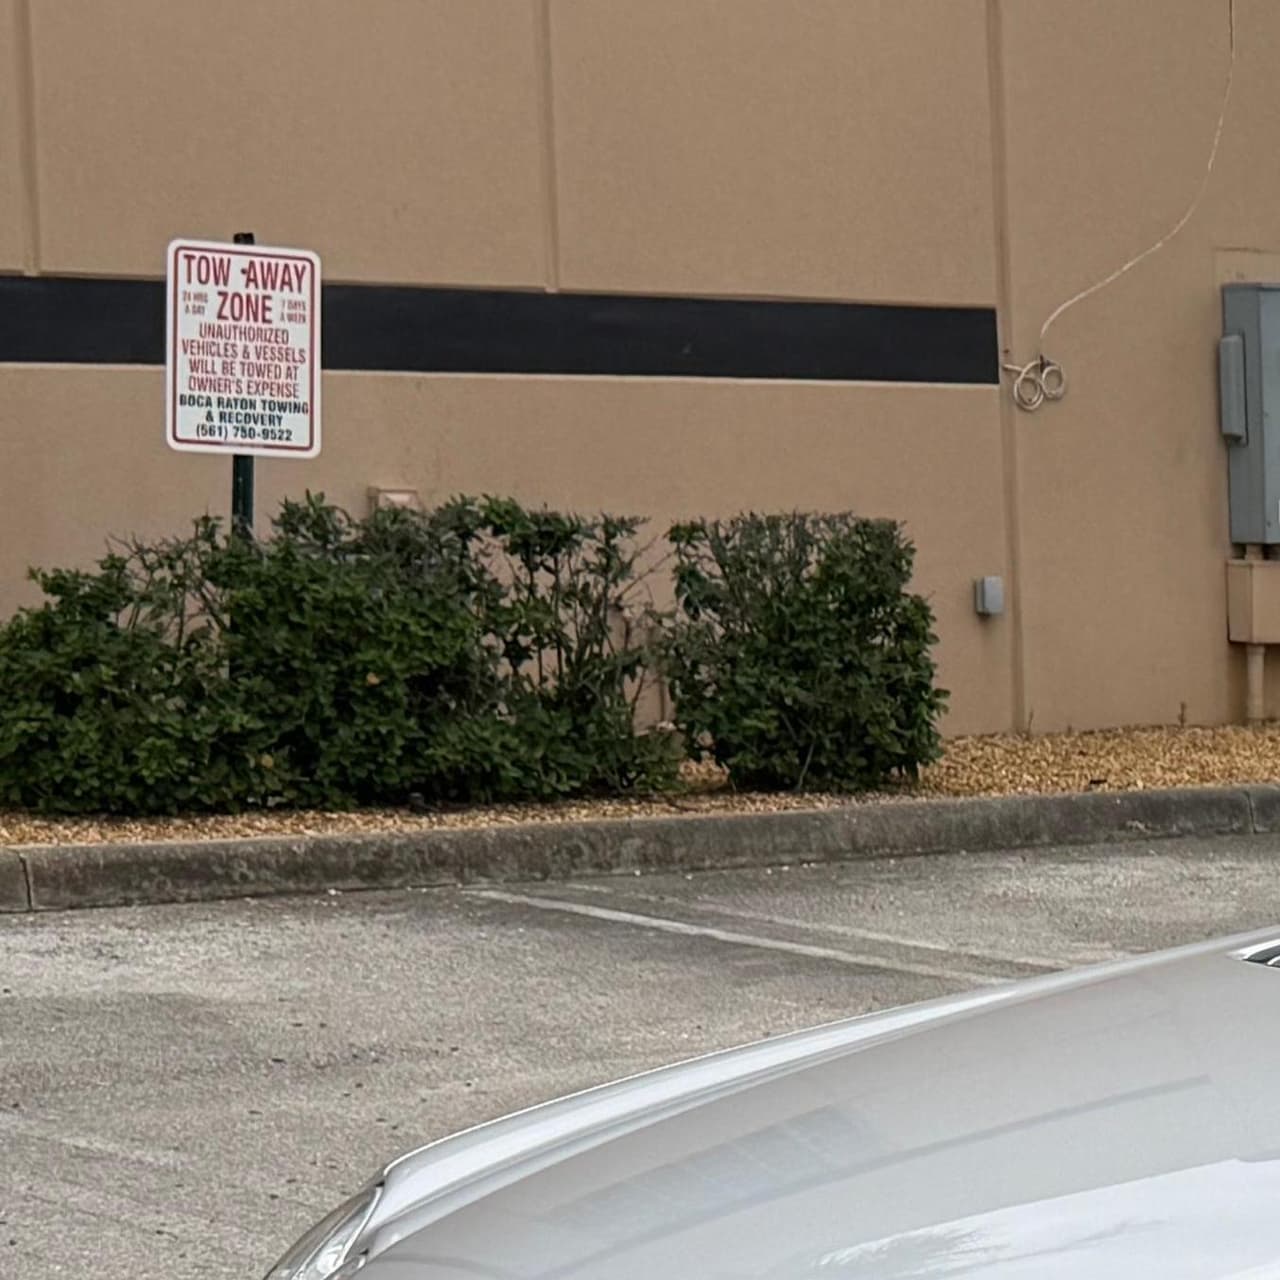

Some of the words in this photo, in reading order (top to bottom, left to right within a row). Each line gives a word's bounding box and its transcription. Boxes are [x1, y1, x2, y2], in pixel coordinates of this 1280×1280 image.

[183, 254, 231, 287] TOW
[245, 260, 306, 294] AWAY
[217, 291, 273, 324] ZONE
[199, 322, 289, 345] UNAUTHORIZED
[182, 338, 238, 359] VEHICLES
[242, 344, 250, 359] &
[255, 344, 306, 364] VESSELS
[189, 358, 217, 375] WILL
[222, 360, 236, 377] BE
[240, 361, 282, 380] TOWED
[285, 365, 299, 381] AT
[188, 375, 243, 395] OWNER'S
[247, 380, 300, 399] EXPENSE
[179, 394, 213, 408] BOCA
[217, 397, 257, 411] RATON
[262, 400, 309, 415] TOWING
[205, 410, 214, 422] &
[219, 411, 283, 427] RECOVERY
[196, 424, 228, 440] (561)
[232, 425, 293, 441] 750-9522
